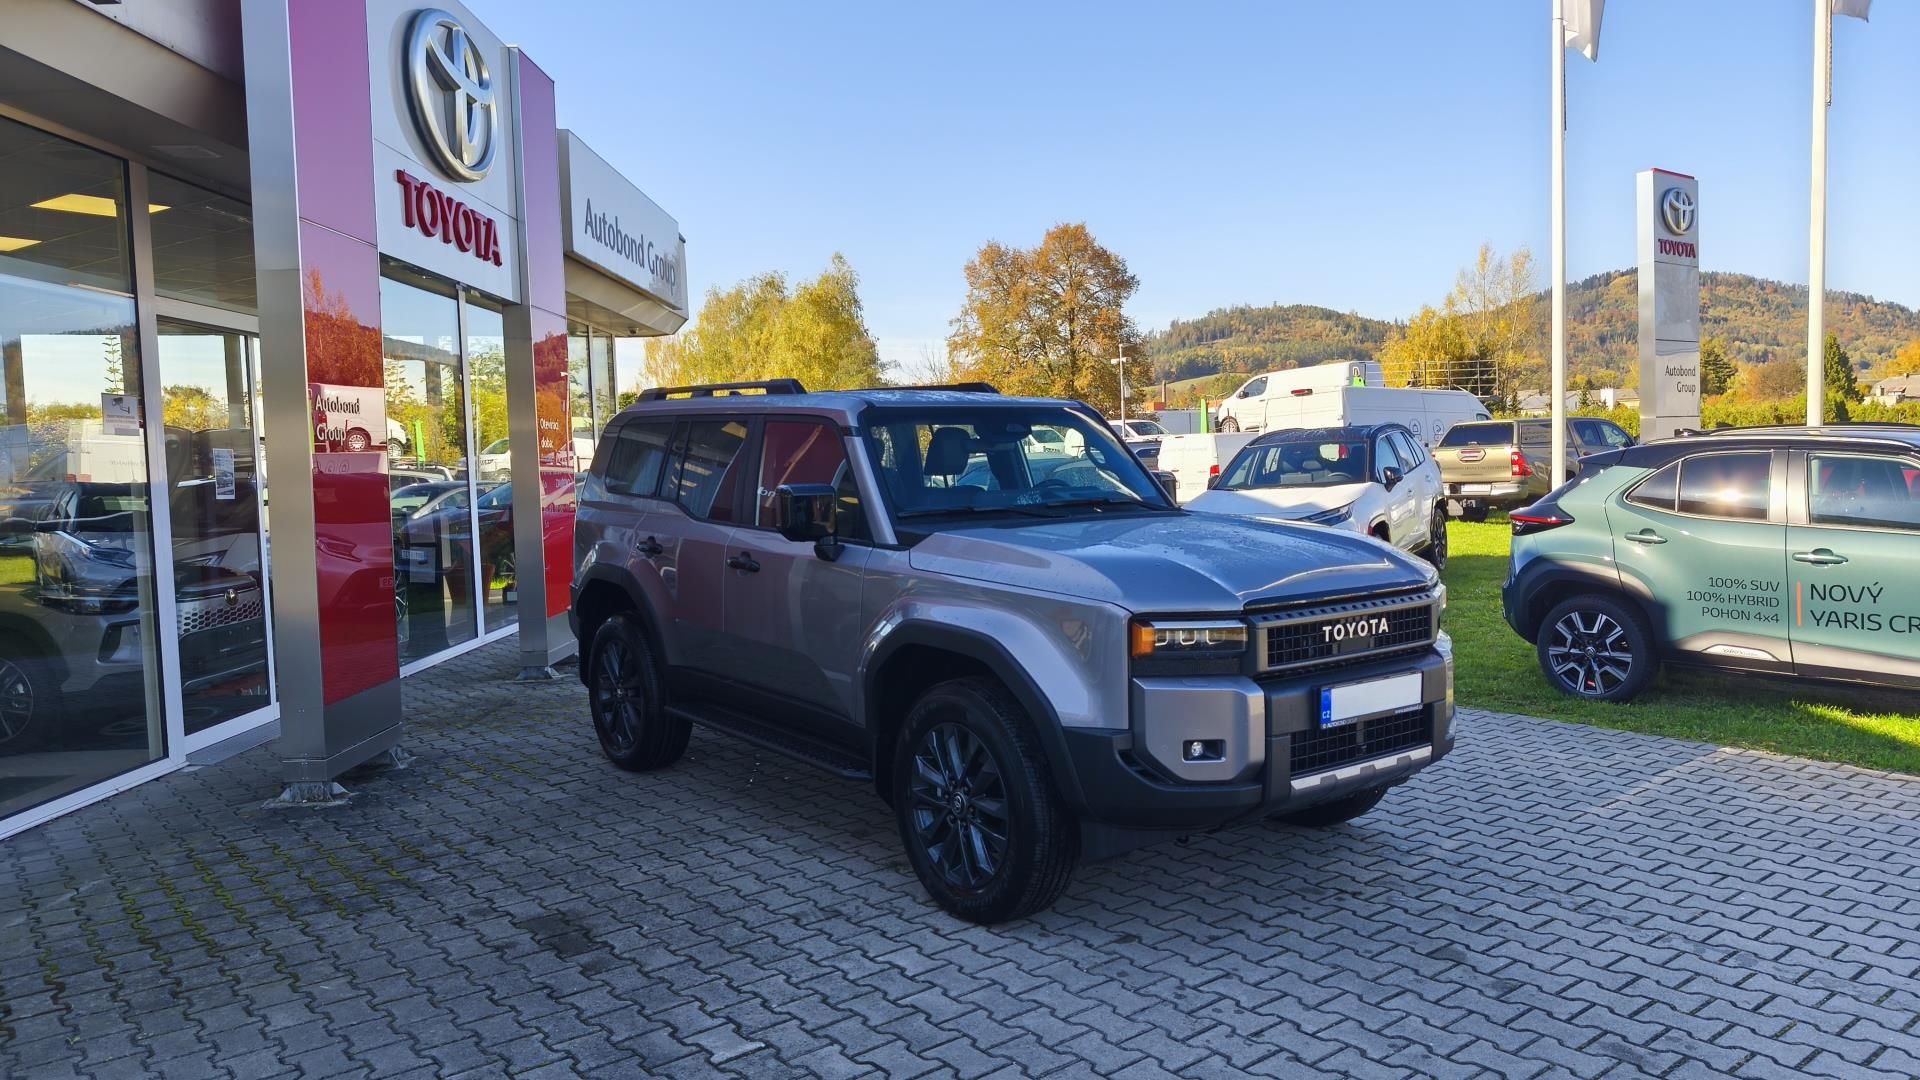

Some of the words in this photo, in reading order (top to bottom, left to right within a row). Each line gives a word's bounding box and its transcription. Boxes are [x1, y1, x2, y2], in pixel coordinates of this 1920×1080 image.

[396, 169, 502, 267] TOYOTA
[585, 198, 645, 268] Autobond
[647, 241, 676, 296] Group
[1658, 238, 1696, 258] TOYOTA
[1665, 364, 1696, 377] Autobond
[1676, 381, 1696, 397] Group
[316, 394, 360, 414] Autobond
[316, 424, 346, 447] Group
[1708, 576, 1748, 590] 100%
[1750, 580, 1780, 593] SUV
[1810, 581, 1884, 604] NOVÝ
[1686, 590, 1725, 604] 100%
[1728, 594, 1780, 608] HYBRID
[1702, 606, 1751, 621] POHON
[1753, 611, 1780, 624] 4x4
[1809, 609, 1883, 631] YARIS
[1322, 617, 1389, 642] TOYOTA
[1322, 710, 1331, 719] CZ
